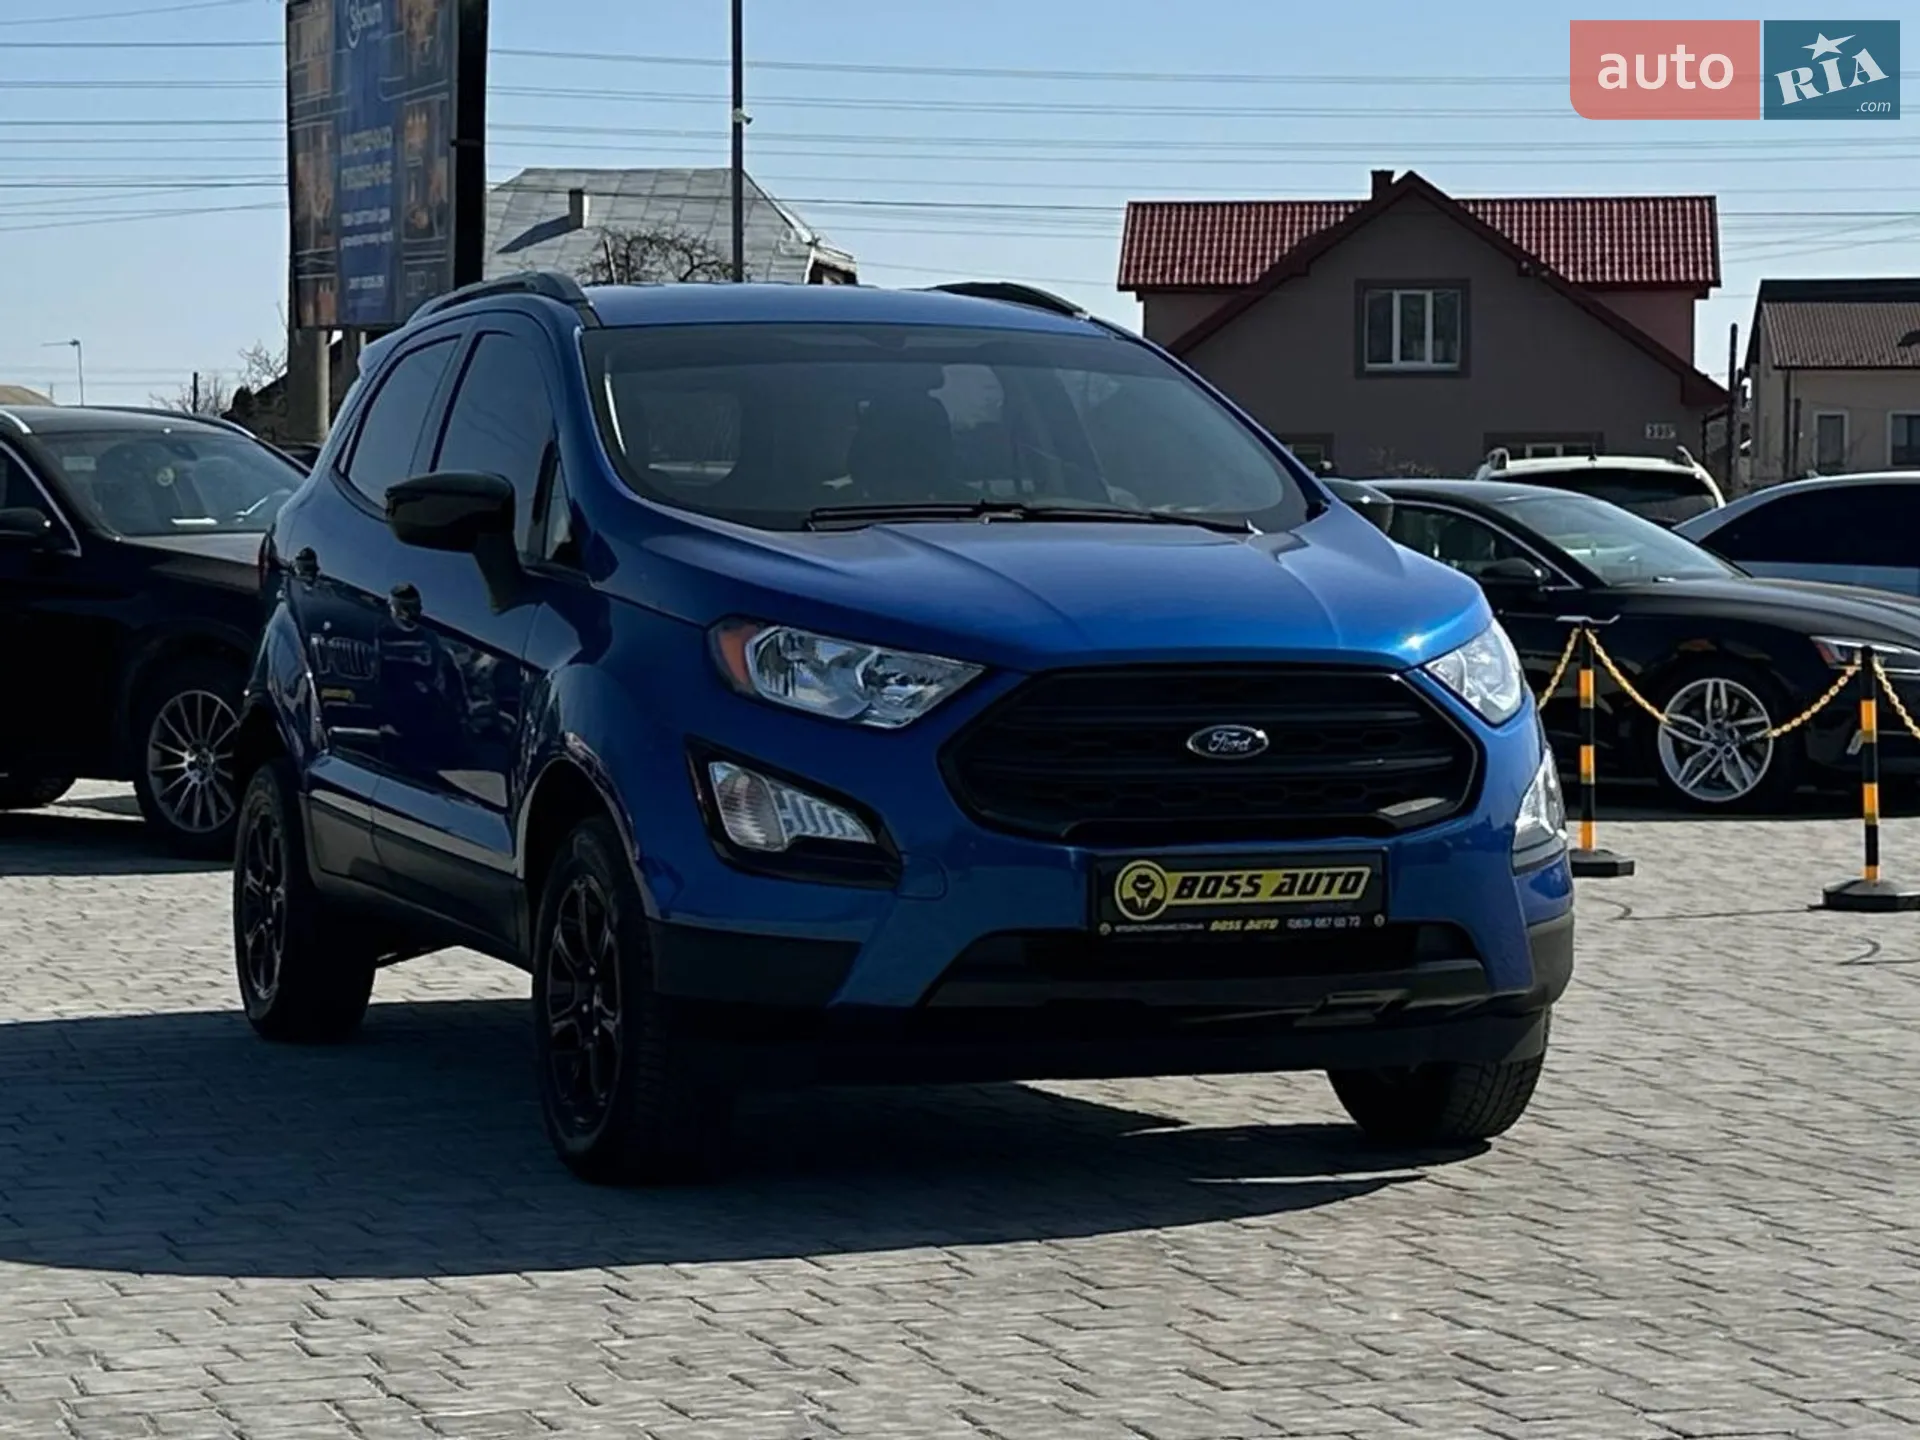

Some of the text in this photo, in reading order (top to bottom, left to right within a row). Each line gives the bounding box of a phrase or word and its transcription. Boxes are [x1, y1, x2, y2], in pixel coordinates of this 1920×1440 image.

[1208, 730, 1252, 752] Ford
[1174, 872, 1365, 899] BOSS AUTO
